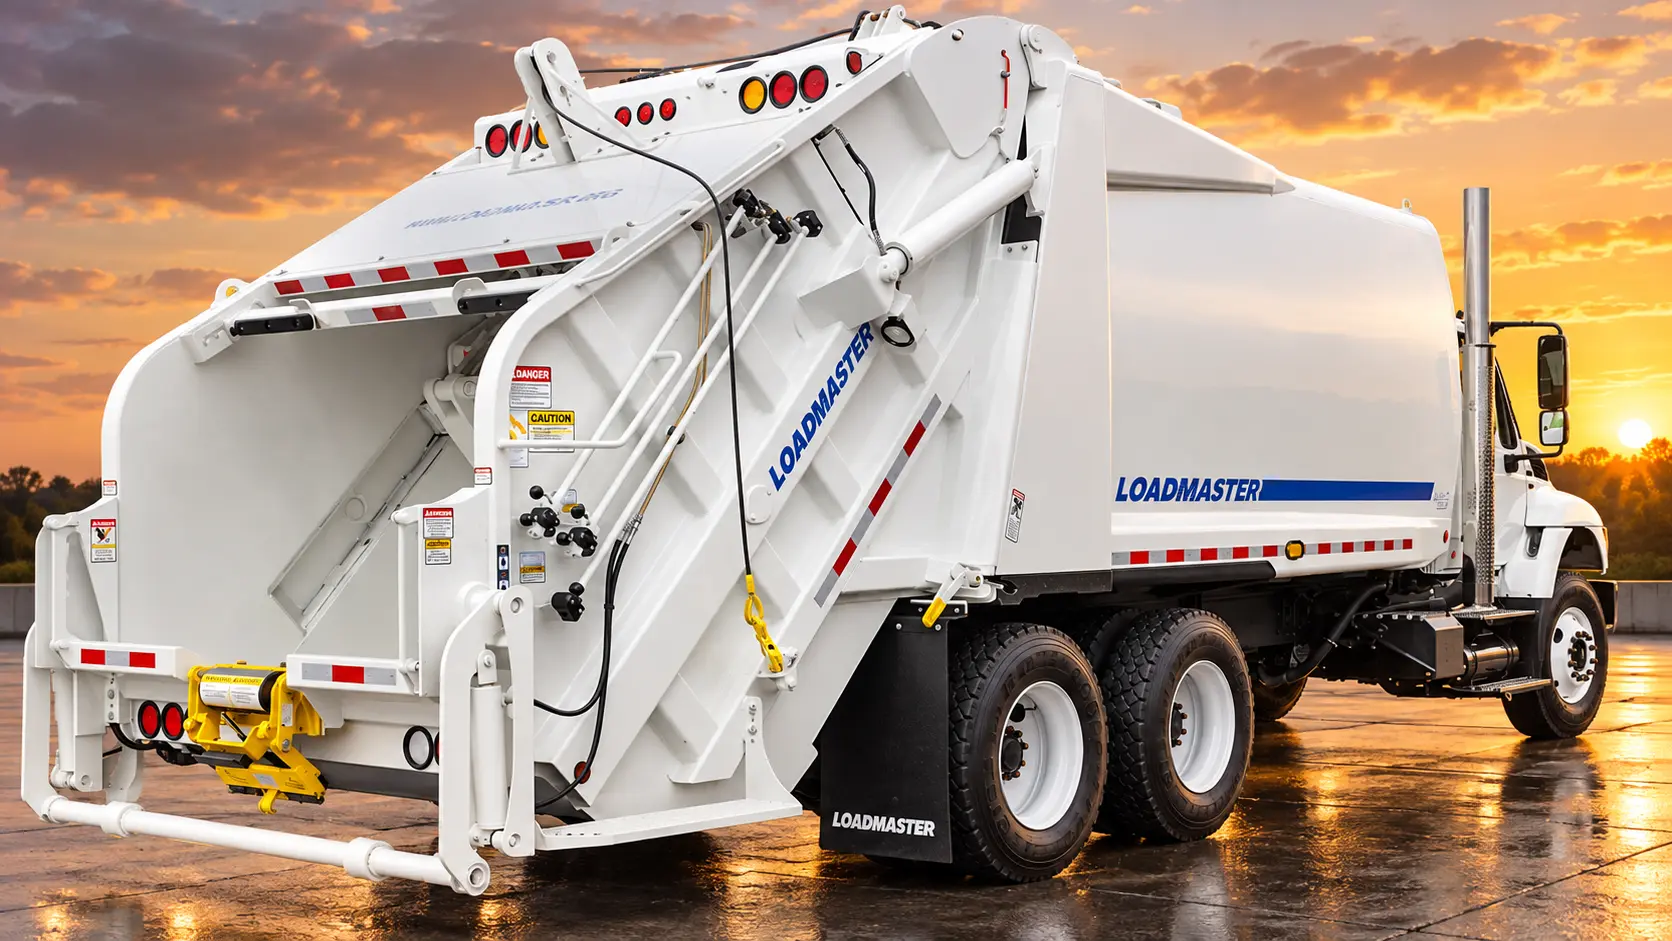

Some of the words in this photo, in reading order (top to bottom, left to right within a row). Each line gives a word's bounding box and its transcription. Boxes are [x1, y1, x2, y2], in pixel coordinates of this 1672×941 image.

[530, 413, 571, 423] CAUTION
[768, 322, 875, 491] LOADMASTER
[1115, 476, 1261, 502] LOADMASTER
[832, 811, 936, 837] LOADMASTER
